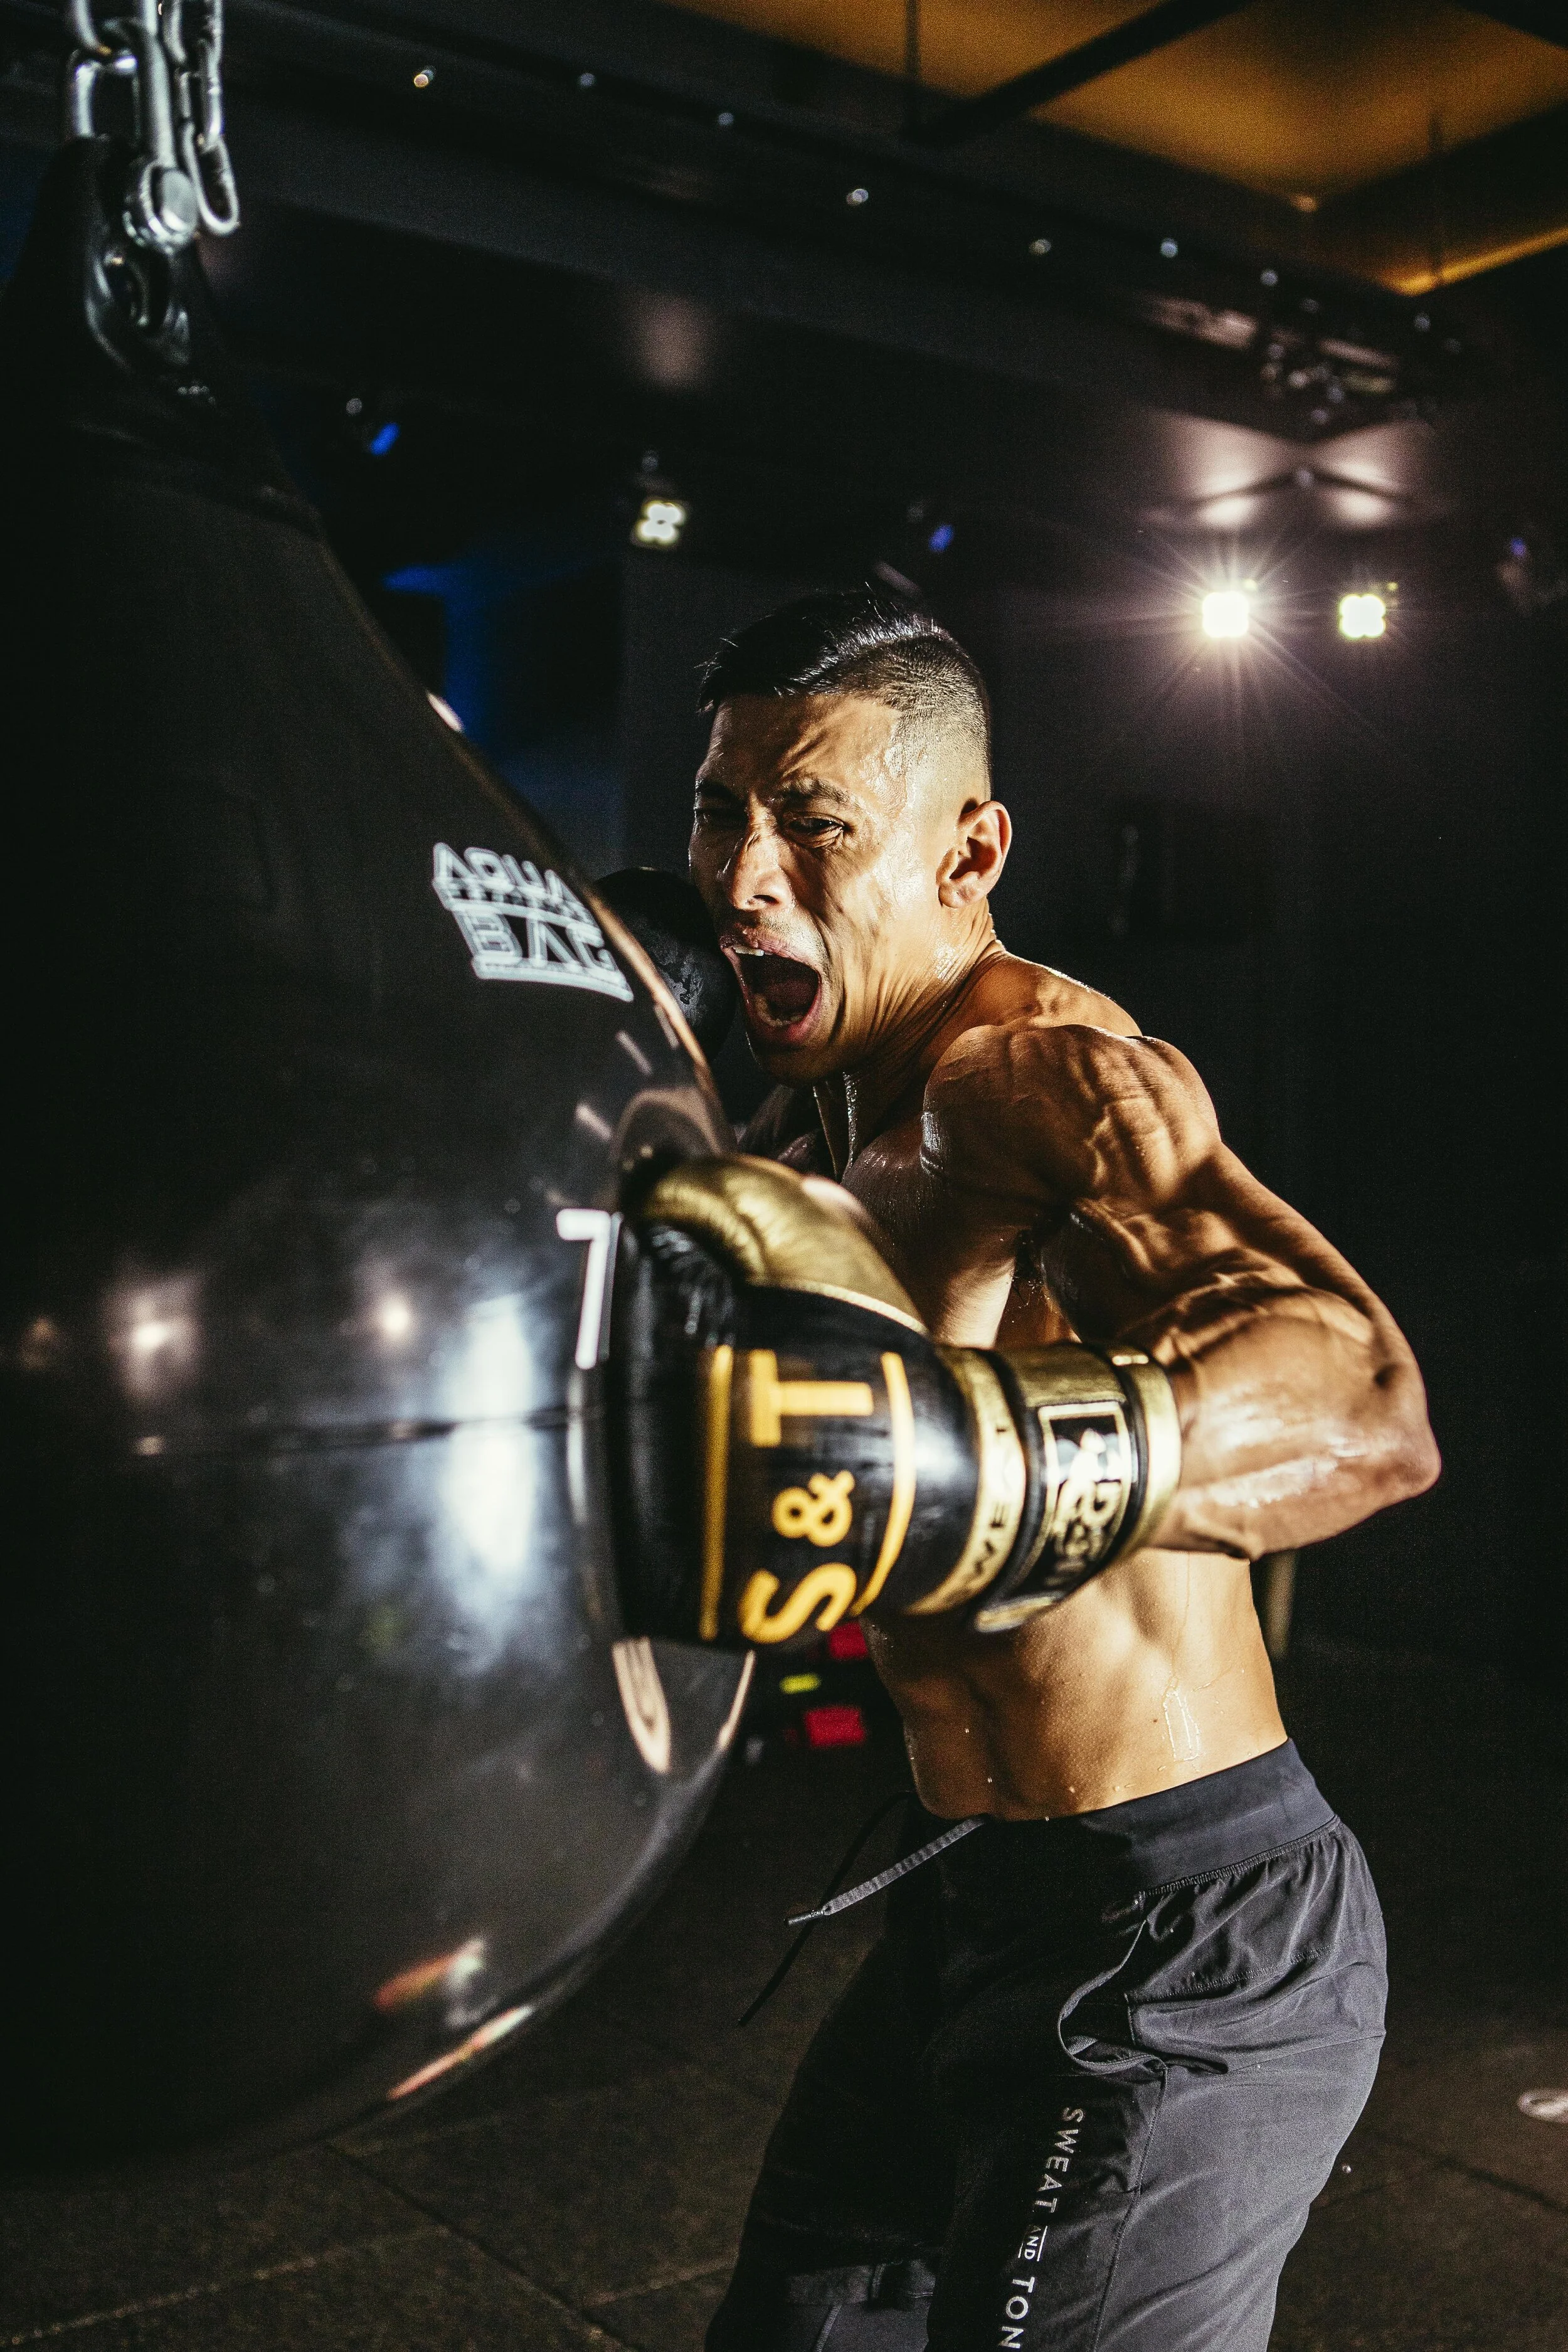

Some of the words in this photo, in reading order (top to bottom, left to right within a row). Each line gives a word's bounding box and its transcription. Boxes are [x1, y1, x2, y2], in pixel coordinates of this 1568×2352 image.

[1035, 2106, 1085, 2214] SWEAT
[1022, 2223, 1044, 2260] AND
[998, 2276, 1036, 2349] TON
